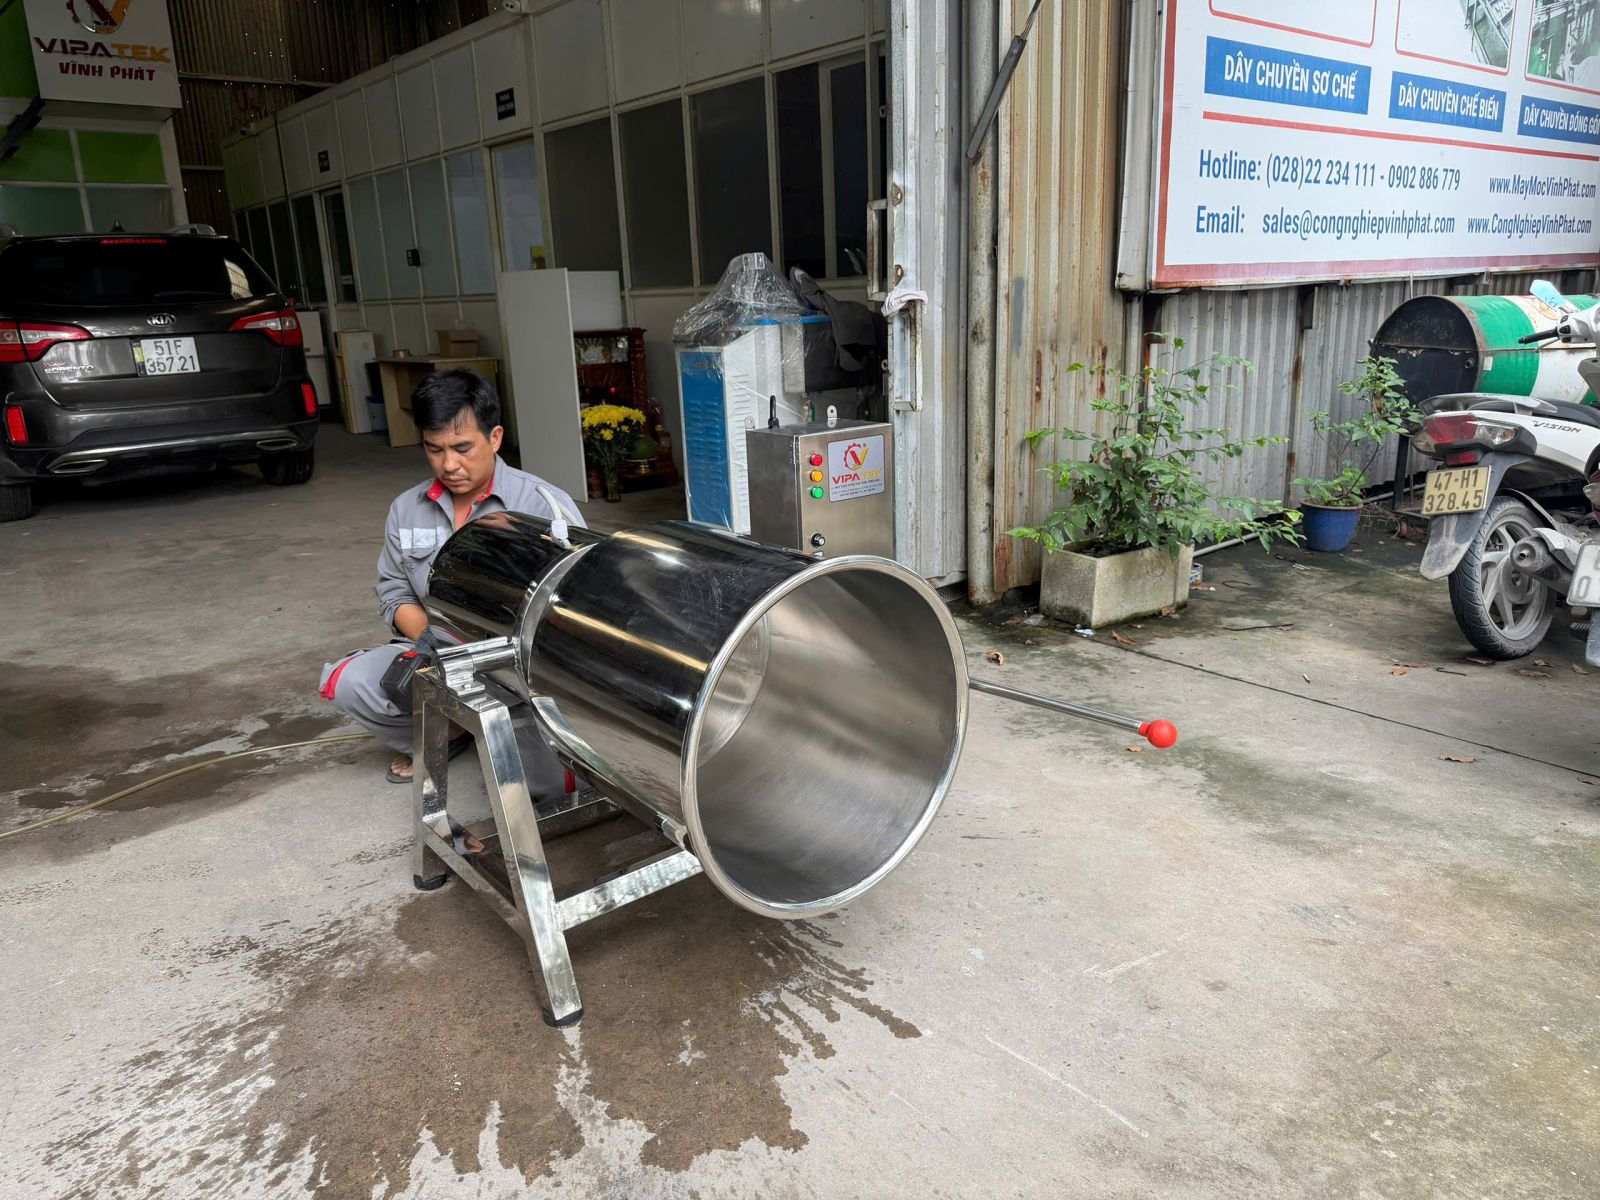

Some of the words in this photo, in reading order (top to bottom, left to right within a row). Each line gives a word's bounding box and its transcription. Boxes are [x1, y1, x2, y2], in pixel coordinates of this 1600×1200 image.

[33, 37, 171, 63] VIPATEK
[59, 61, 103, 76] VĨNH
[110, 66, 155, 81] PHÁT
[1224, 50, 1253, 84] DÂY
[1255, 59, 1309, 93] CHUYỀN
[1312, 70, 1330, 96] SƠ
[1332, 70, 1358, 100] CHẾ
[1398, 82, 1419, 108] DÂY
[1420, 86, 1458, 114] CHUYỀN
[1460, 92, 1480, 118] CHẾ
[1479, 94, 1500, 121] BIẾN
[1523, 103, 1539, 126] DÂY
[1540, 107, 1569, 131] CHUYỀN
[1199, 149, 1262, 181] Hotline:
[1266, 152, 1322, 190] (028)22
[1325, 159, 1350, 186] 234
[1354, 161, 1376, 187] 111
[1388, 164, 1417, 189] 0902
[1419, 167, 1439, 190] 886
[1441, 168, 1461, 191] 779
[1489, 174, 1596, 200] www.MayMocVinhPhat.com
[1196, 205, 1245, 234] Email:
[1262, 206, 1455, 241] sales@congnghiepvinhphat.com
[1467, 213, 1592, 239] www.CongNghiepVinhPhat.com
[151, 314, 174, 326] KIA
[146, 355, 196, 374] 357.21
[1533, 420, 1582, 433] VISION
[1434, 469, 1479, 492] 47-H1
[1425, 489, 1484, 513] 328.45
